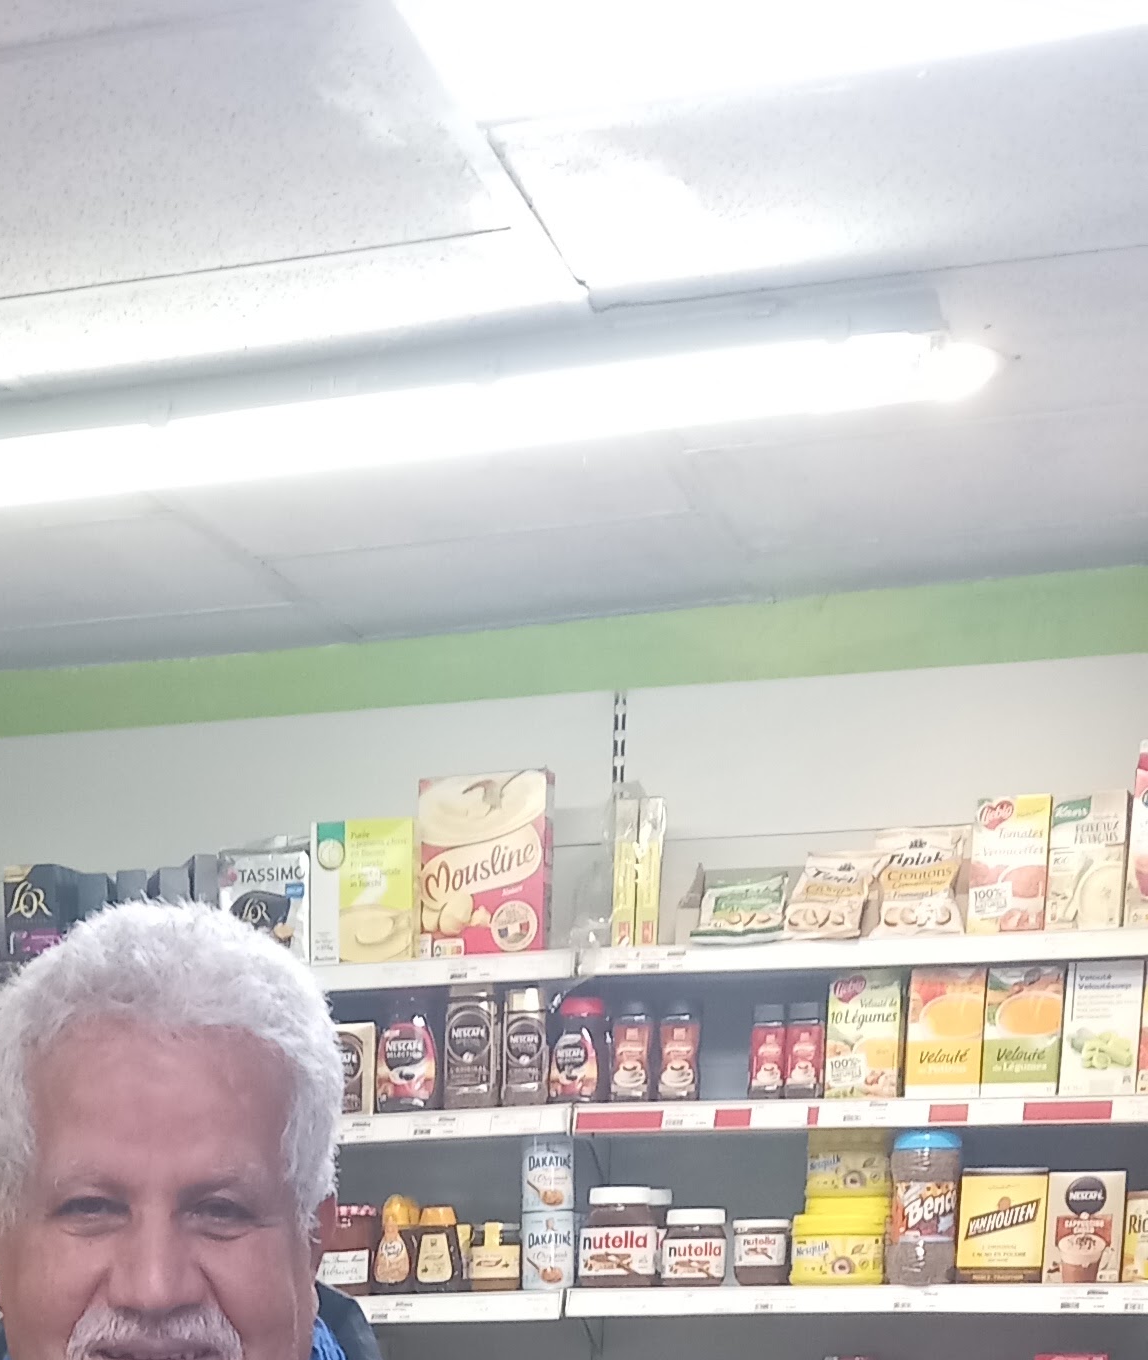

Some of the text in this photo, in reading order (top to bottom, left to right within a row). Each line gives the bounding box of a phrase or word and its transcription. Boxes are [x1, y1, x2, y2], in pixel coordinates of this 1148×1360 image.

[239, 866, 306, 884] TASSIMO
[425, 840, 536, 902] Mousline
[844, 1009, 898, 1030] Légumes
[919, 1048, 971, 1064] Velouté
[996, 1046, 1046, 1062] Velouté
[582, 1227, 649, 1250] nutella
[743, 1236, 777, 1247] nutella
[668, 1240, 722, 1259] nutella
